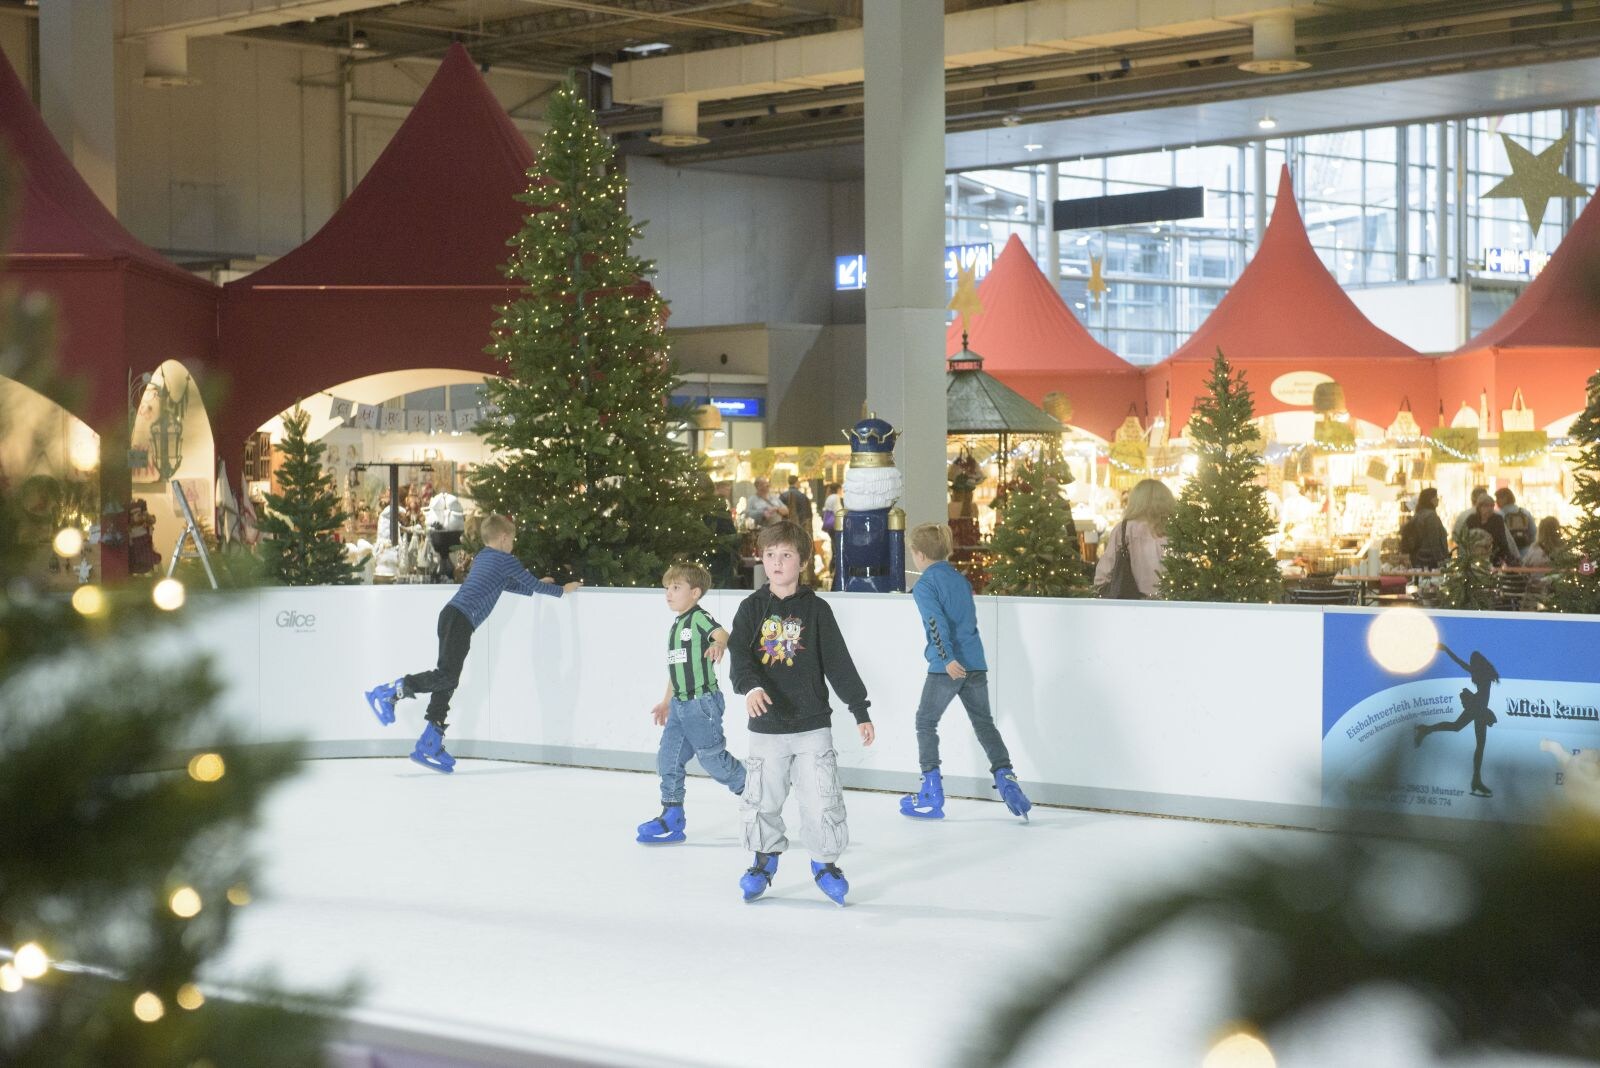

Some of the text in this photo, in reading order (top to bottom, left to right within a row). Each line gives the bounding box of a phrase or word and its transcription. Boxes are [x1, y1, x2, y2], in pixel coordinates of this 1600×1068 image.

[275, 610, 316, 628] Glice
[1346, 695, 1454, 739] Eisbahnverleih Munster
[1505, 697, 1599, 721] Mich kann
[1431, 786, 1464, 797] Munster
